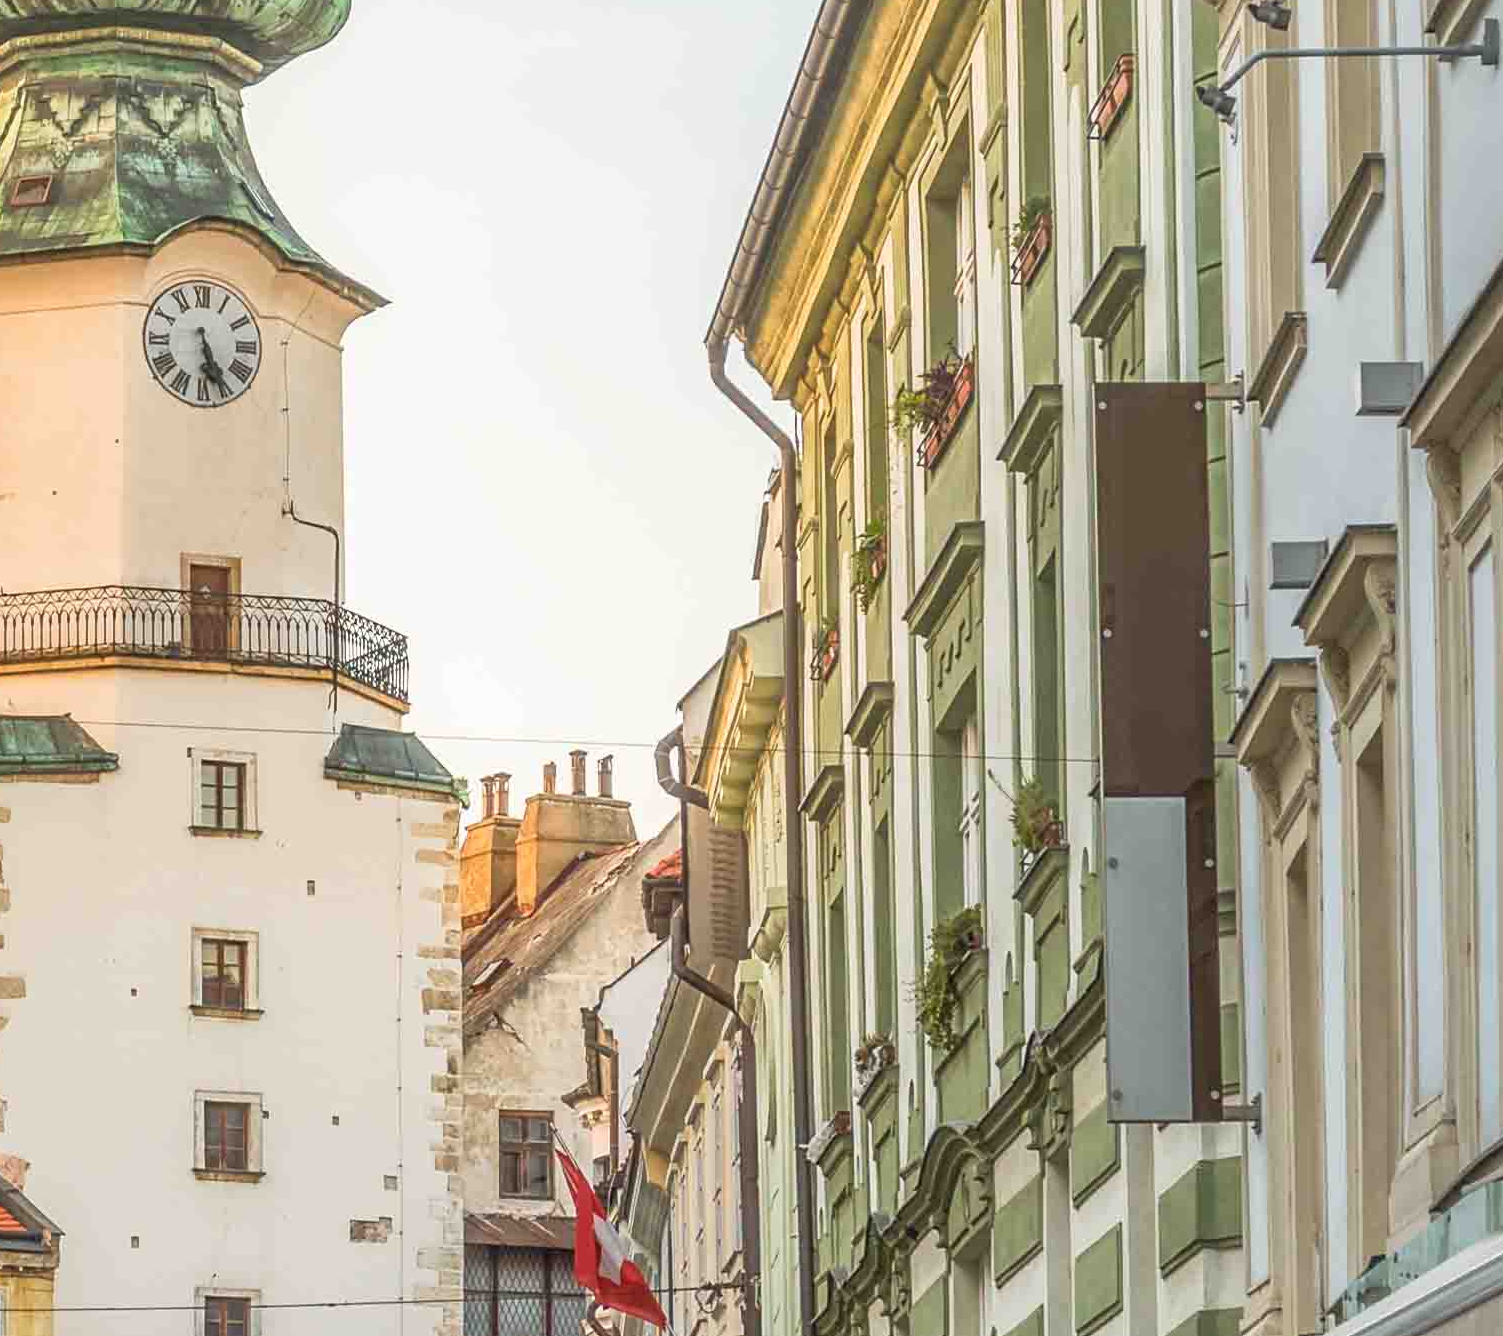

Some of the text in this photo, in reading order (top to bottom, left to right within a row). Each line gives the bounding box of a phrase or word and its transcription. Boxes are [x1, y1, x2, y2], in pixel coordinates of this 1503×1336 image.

[171, 289, 191, 313] XI
[194, 286, 211, 308] XII
[217, 294, 230, 314] I
[155, 306, 176, 326] X
[229, 314, 251, 332] II
[235, 341, 257, 355] III
[152, 352, 177, 378] VIII
[169, 368, 192, 396] VII
